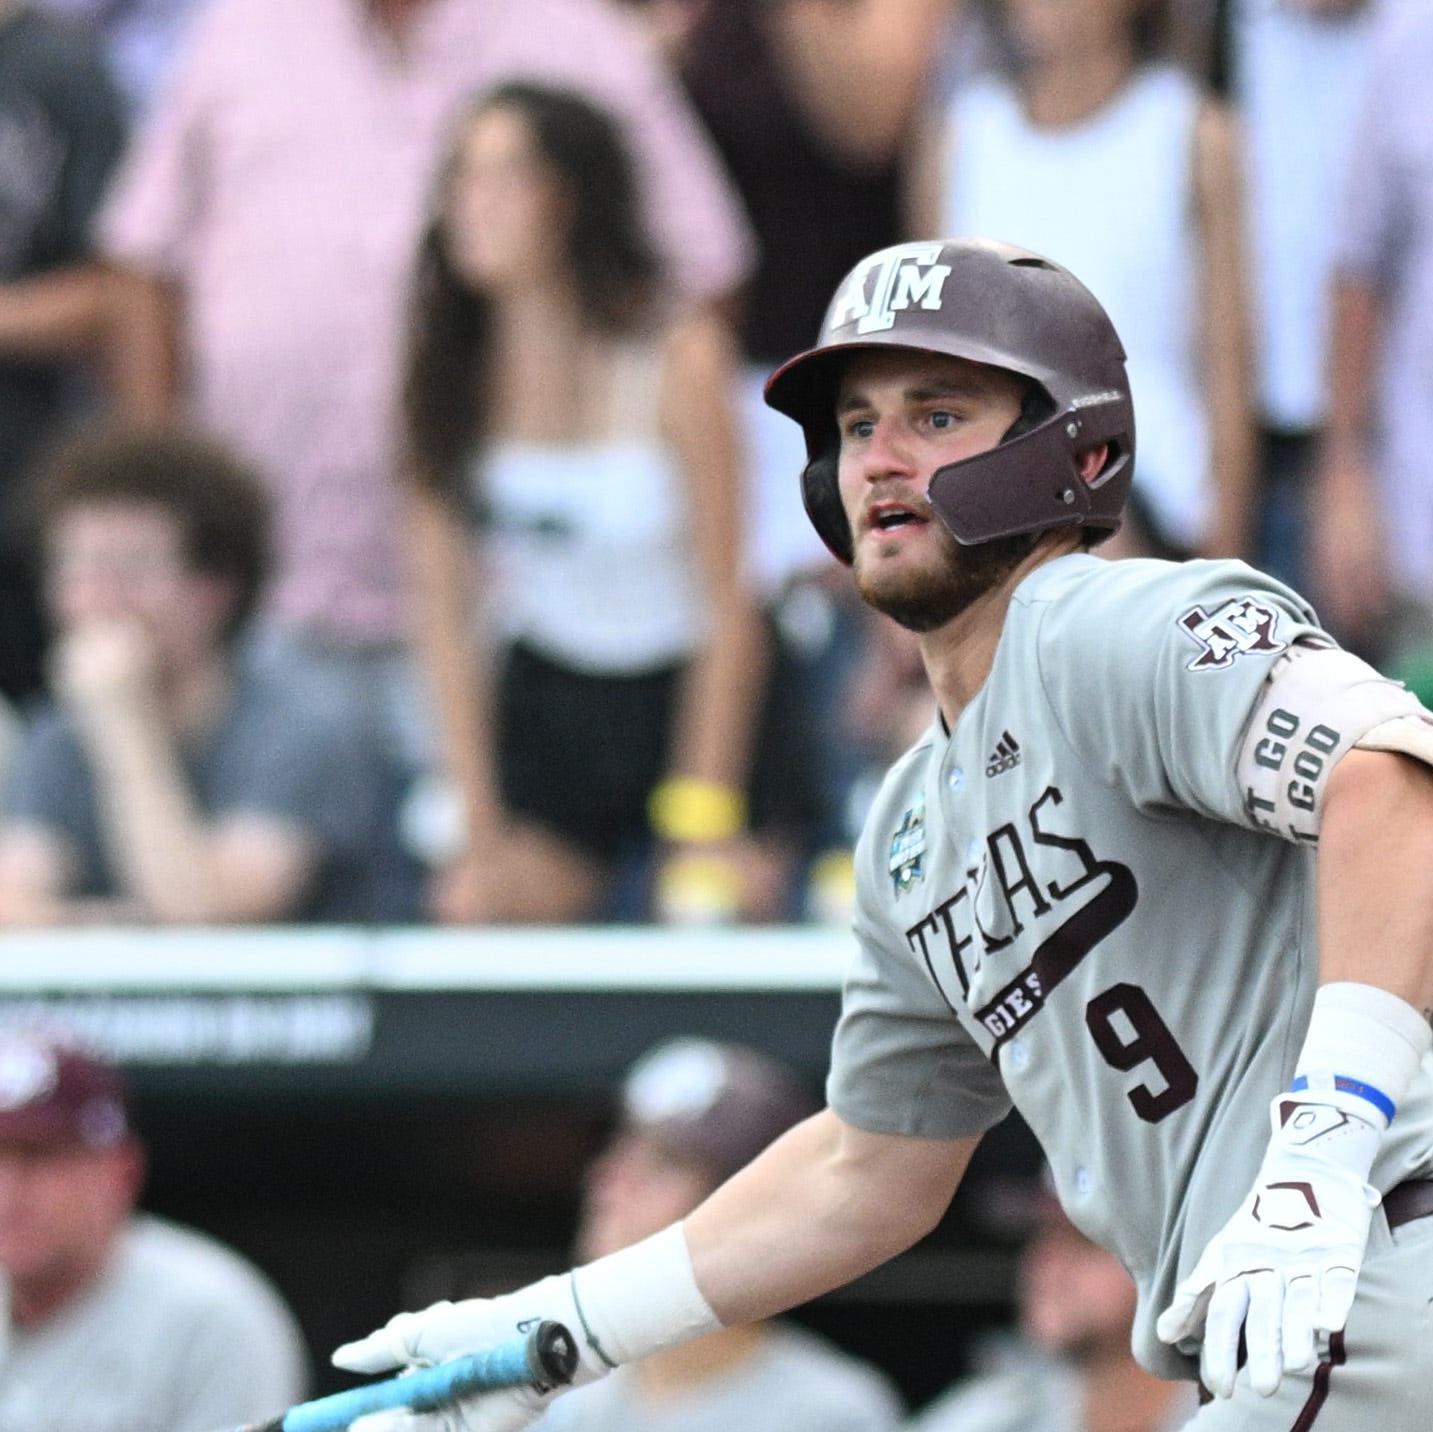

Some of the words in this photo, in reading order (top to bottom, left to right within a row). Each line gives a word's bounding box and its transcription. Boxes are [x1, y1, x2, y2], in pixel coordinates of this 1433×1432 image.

[985, 751, 1022, 779] adidas
[1254, 708, 1300, 772] GO
[1287, 724, 1341, 812] GOD
[1085, 982, 1200, 1125] 9
